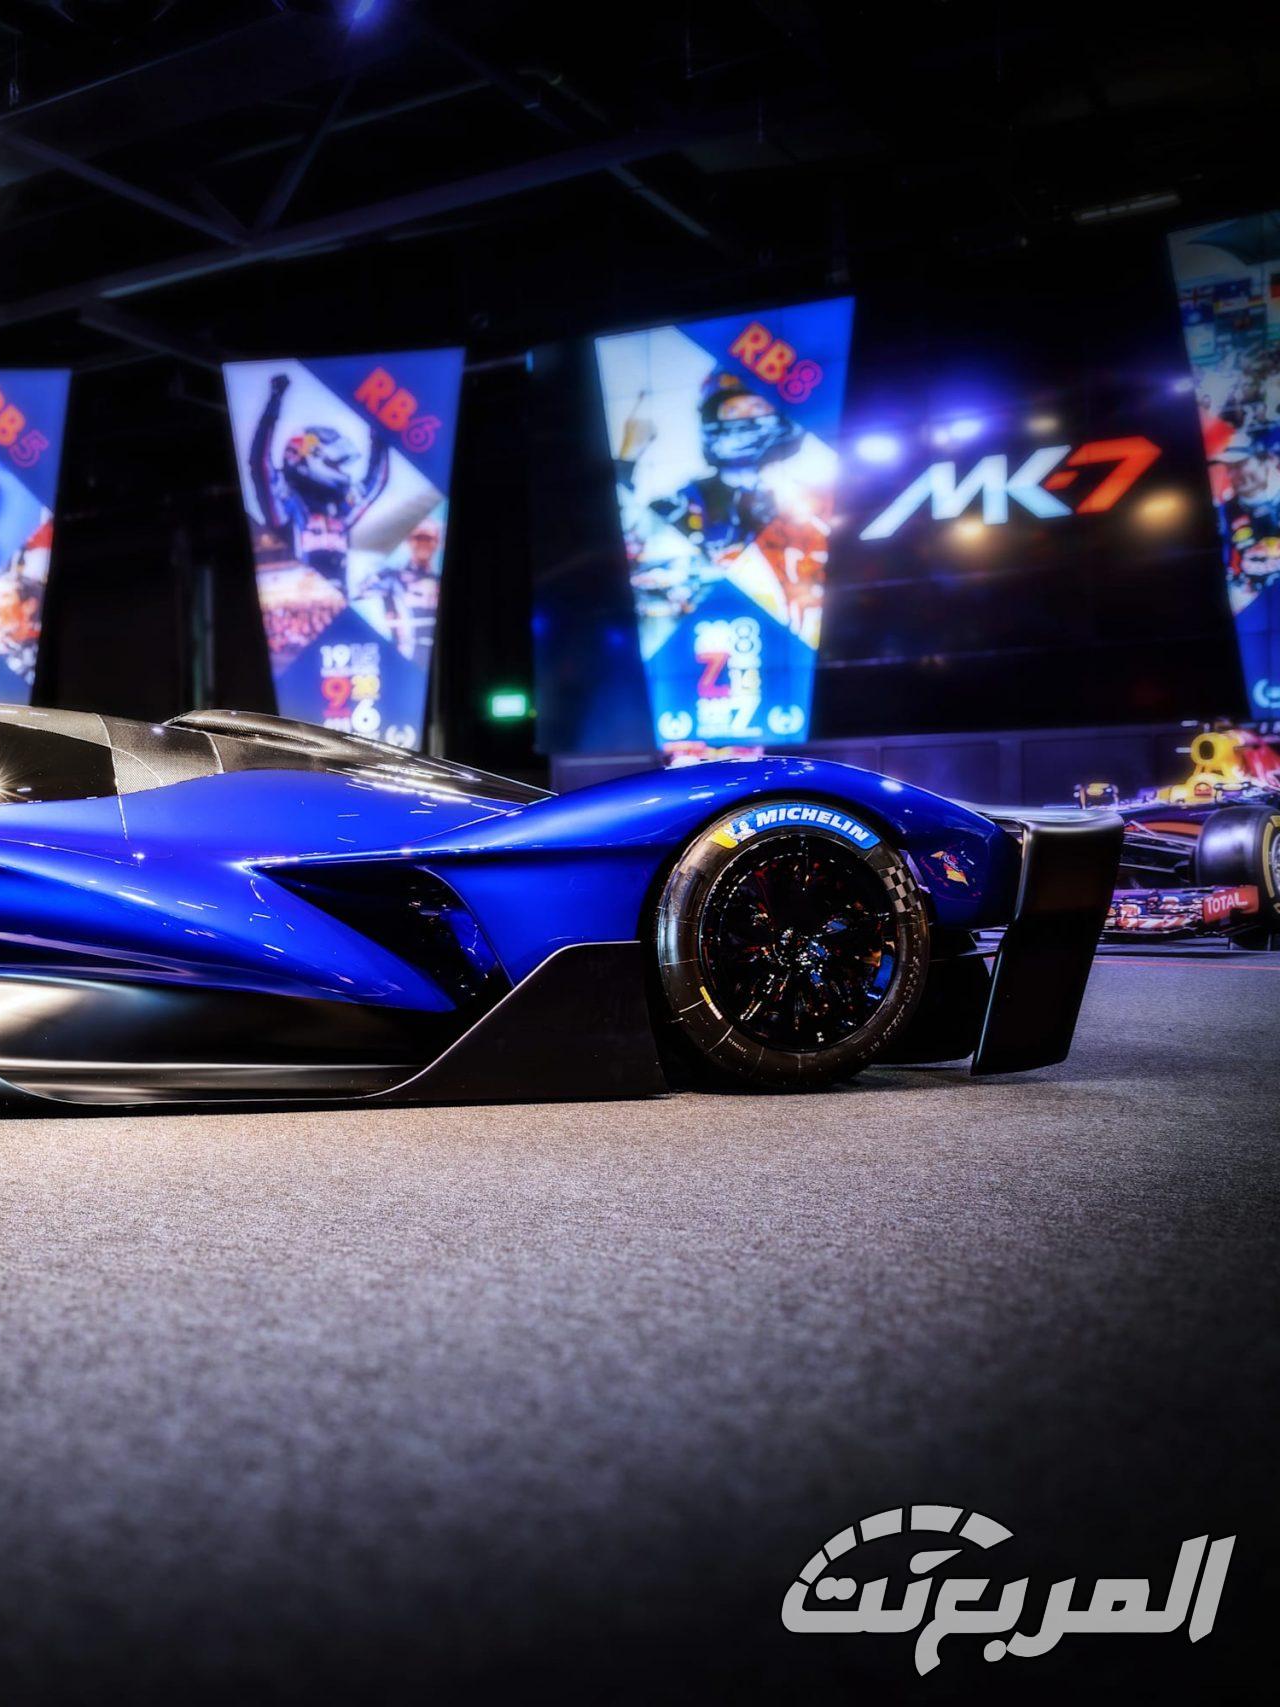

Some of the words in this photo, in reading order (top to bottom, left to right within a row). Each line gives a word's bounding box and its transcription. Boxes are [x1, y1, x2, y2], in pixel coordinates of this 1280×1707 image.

[728, 321, 824, 404] RB8
[354, 366, 443, 453] RB6
[351, 699, 381, 733] 6
[756, 807, 869, 841] MICHELIN
[1206, 892, 1248, 915] TOTAL
